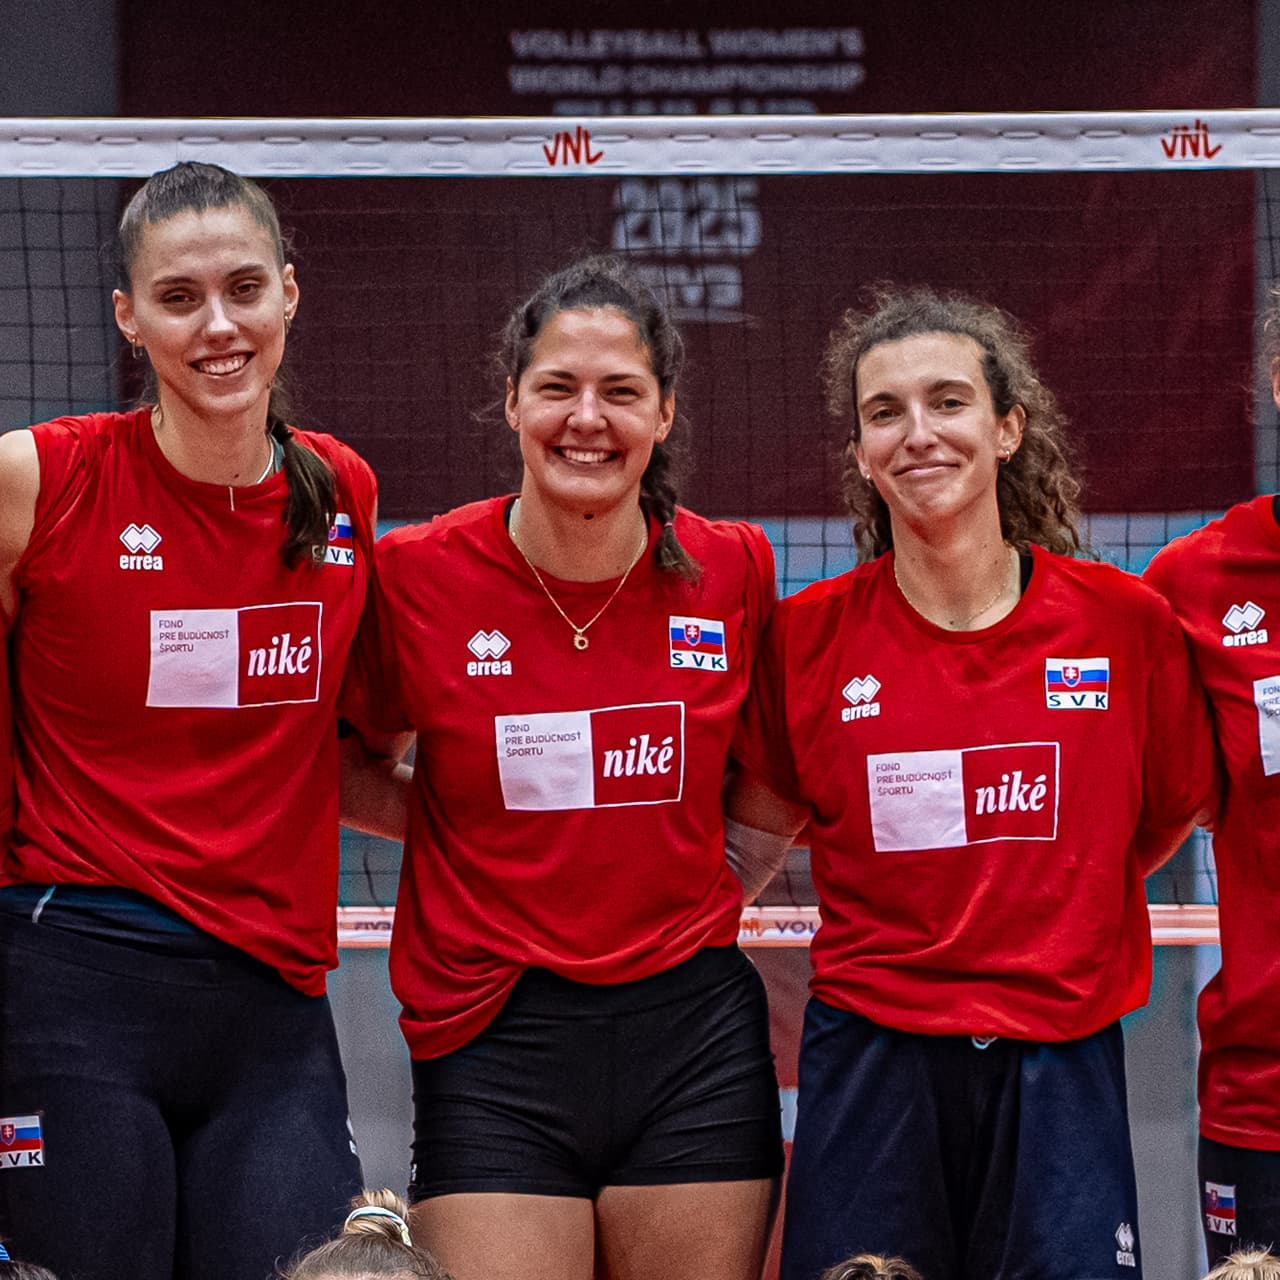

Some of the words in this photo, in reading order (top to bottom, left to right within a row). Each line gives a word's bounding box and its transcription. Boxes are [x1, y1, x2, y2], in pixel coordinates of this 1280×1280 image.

[544, 126, 604, 165] VNL
[1160, 119, 1222, 158] VNL
[119, 553, 164, 571] errea
[1222, 628, 1269, 648] errea
[247, 632, 313, 677] niké
[672, 652, 726, 670] SVK
[466, 660, 513, 677] errea
[1048, 694, 1107, 708] SVK
[840, 702, 881, 723] errea
[602, 734, 675, 778] niké
[975, 770, 1048, 816] niké
